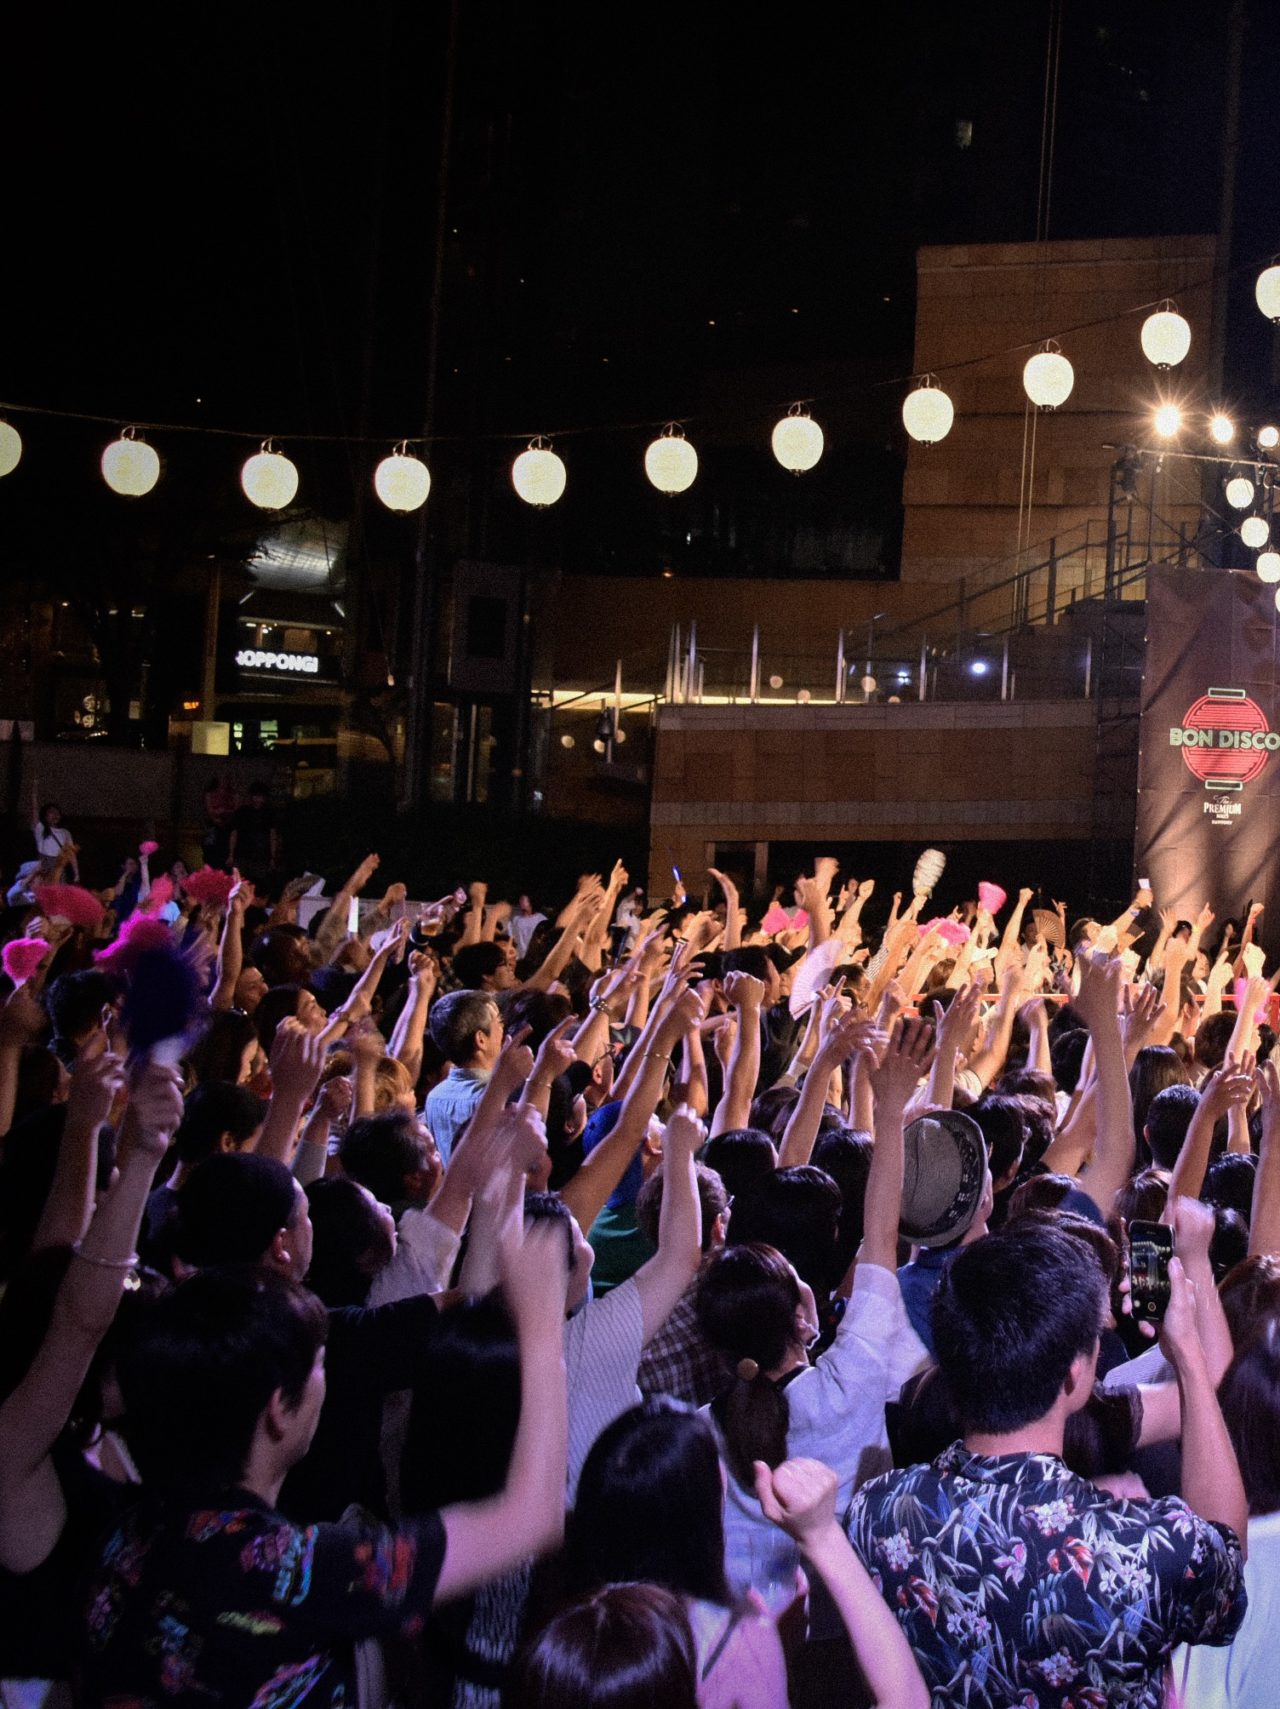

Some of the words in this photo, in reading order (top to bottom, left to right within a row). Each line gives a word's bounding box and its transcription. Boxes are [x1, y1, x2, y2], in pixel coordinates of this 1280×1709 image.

[1169, 728, 1214, 747] BON
[1219, 730, 1280, 750] DISCO
[1203, 802, 1242, 816] PREMIUM
